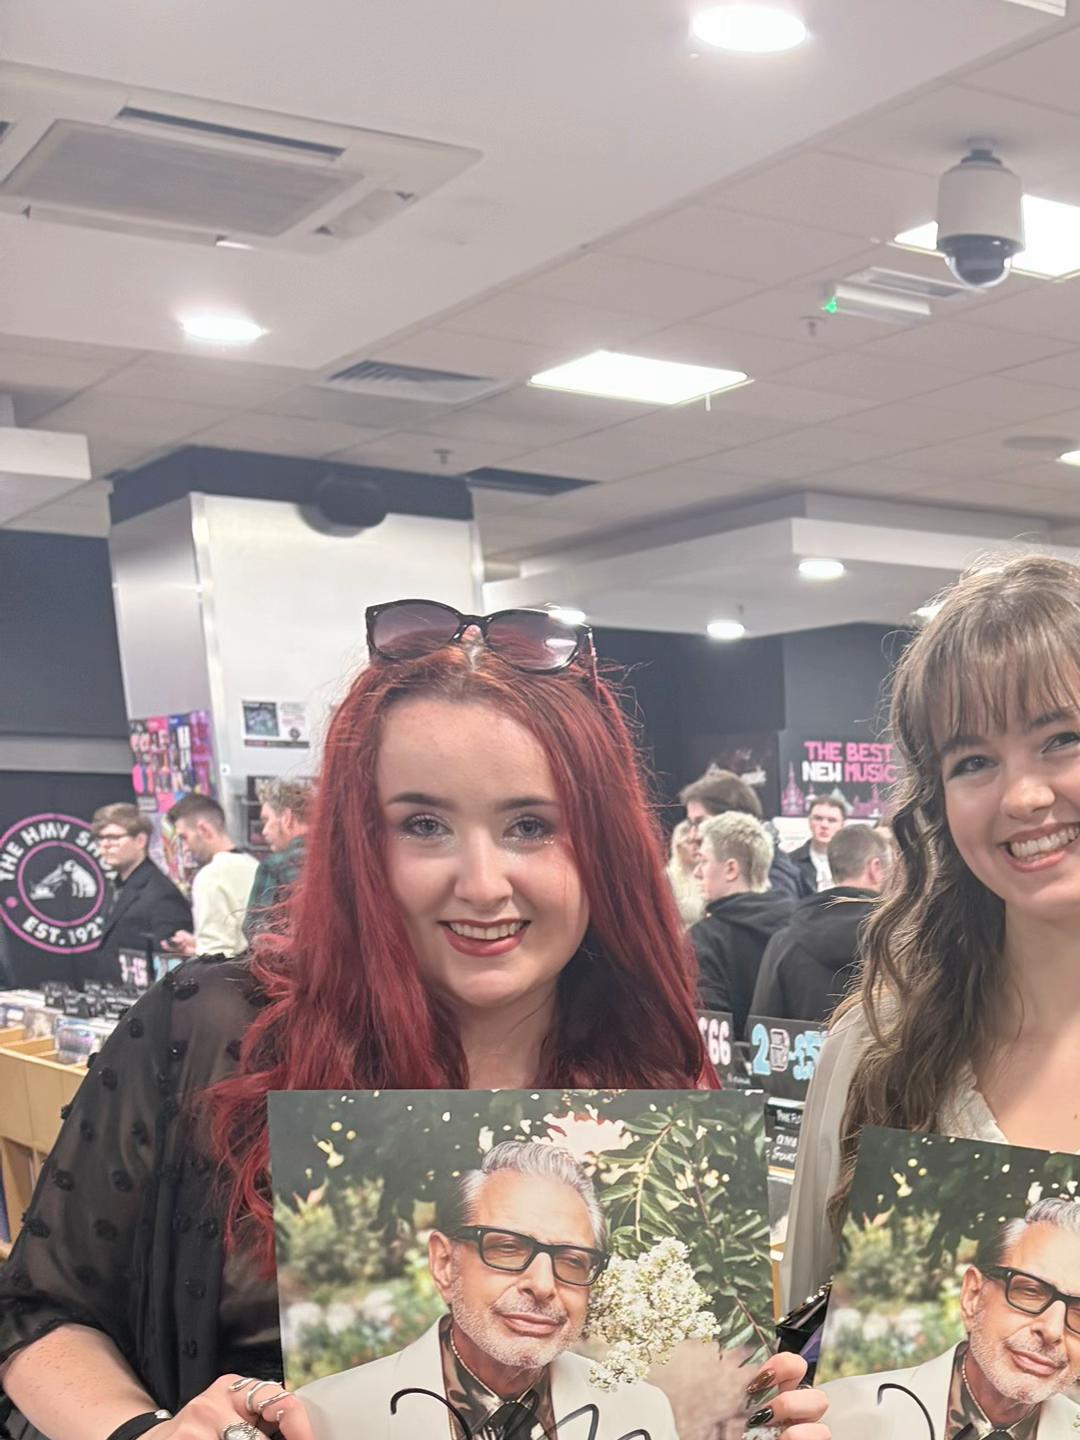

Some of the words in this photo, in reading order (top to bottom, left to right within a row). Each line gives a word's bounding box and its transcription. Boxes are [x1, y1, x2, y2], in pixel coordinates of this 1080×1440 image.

[804, 741, 842, 761] THE
[845, 742, 893, 762] BEST
[802, 761, 842, 782] NEW
[844, 763, 897, 783] MUSIC
[0, 841, 25, 882] THE
[20, 821, 71, 846] HMV
[22, 915, 65, 946] EST.
[67, 916, 104, 945] 192
